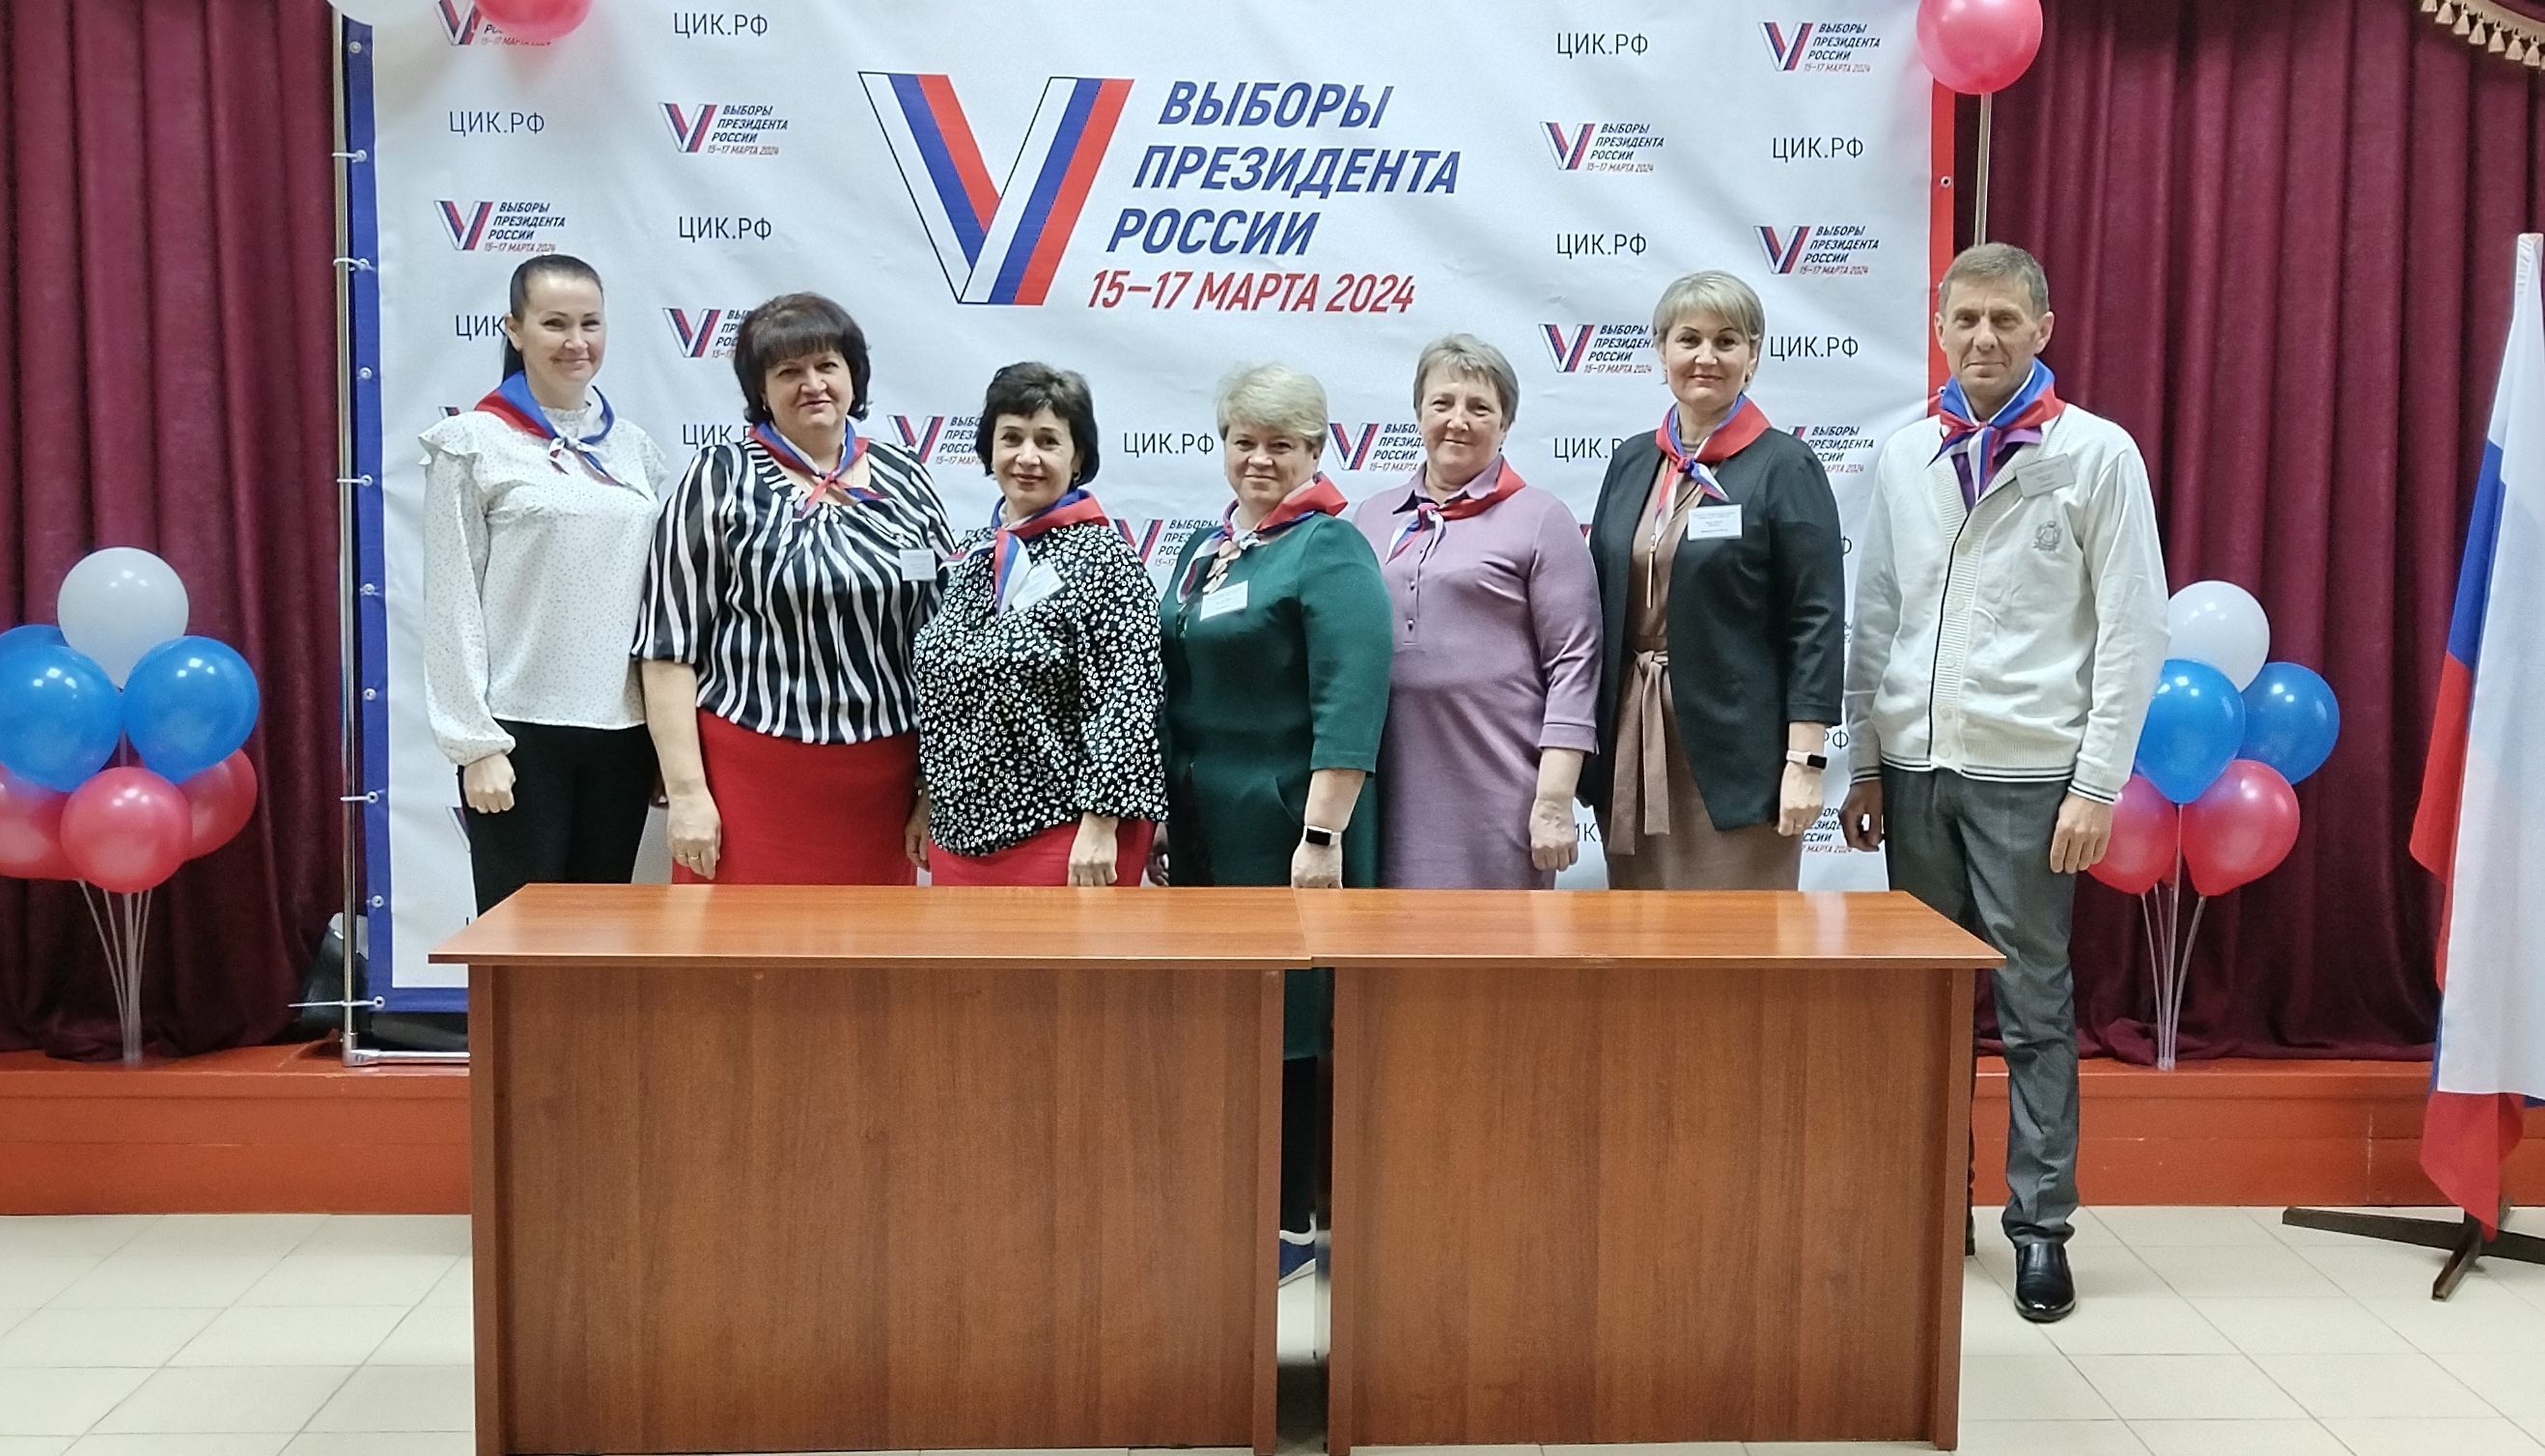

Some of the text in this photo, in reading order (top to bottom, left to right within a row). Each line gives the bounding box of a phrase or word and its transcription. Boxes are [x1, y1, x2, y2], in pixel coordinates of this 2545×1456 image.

[674, 13, 769, 39] ЦИК.РФ
[1818, 23, 1868, 34] ВЫБОРЫ
[1556, 33, 1649, 59] ЦИК.РФ
[1813, 37, 1881, 48] ПРЕЗИДЕНТА
[1807, 50, 1852, 61] РОССИИ
[1826, 63, 1851, 72] МАРТА
[1852, 64, 1871, 72] 2024
[1159, 80, 1394, 128] ВЫБОРЫ
[722, 104, 774, 116] ВЫБОРЫ
[449, 110, 545, 137] ЦИК.РФ
[716, 119, 789, 130] ПРЕЗИДЕНТА
[1601, 124, 1651, 133] ВЫБОРЫ
[711, 132, 758, 143] РОССИИ
[1595, 137, 1664, 148] ПРЕЗИДЕНТА
[731, 146, 758, 154] МАРТА
[759, 147, 779, 155] 2024
[1589, 150, 1635, 160] РОССИИ
[1773, 137, 1864, 163] ЦИК.РФ
[1132, 144, 1462, 199] ПРЕЗИДЕНТА
[1608, 163, 1635, 172] МАРТА
[498, 202, 551, 212] ВЫБОРЫ
[493, 215, 566, 227] ПРЕЗИДЕНТА
[488, 230, 535, 240] РОССИИ
[678, 216, 773, 244] ЦИК.РФ
[1106, 208, 1322, 256] РОССИИ
[1815, 226, 1866, 237] ВЫБОРЫ
[508, 243, 536, 252] МАРТА
[536, 243, 556, 252] 2024
[1556, 233, 1648, 260] ЦИК.РФ
[1809, 239, 1880, 250] ПРЕЗИДЕНТА
[1803, 253, 1849, 264] РОССИИ
[1822, 266, 1849, 274] МАРТА
[1849, 266, 1869, 275] 2024
[1195, 271, 1317, 313] МАРТА
[1325, 274, 1416, 314] 2024
[456, 315, 507, 341] ЦИК
[1599, 324, 1650, 335] ВЫБОРЫ
[1593, 338, 1655, 349] ПРЕЗИДЕН
[1769, 335, 1860, 361] ЦИК.РФ
[1588, 351, 1634, 361] РОССИИ
[1606, 365, 1633, 374] МАРТА
[1633, 365, 1653, 374] 2024
[950, 416, 981, 427] ВЫБО
[1384, 423, 1419, 434] ВЫБО
[1811, 426, 1860, 436] ВЫБОРЫ
[1123, 432, 1215, 459] ЦИК.РФ
[1378, 436, 1424, 448] ПРЕЗИД
[1554, 437, 1624, 462] ЦИК.Р
[1373, 450, 1418, 461] РОССИИ
[1816, 452, 1845, 462] ССИИ
[1391, 462, 1418, 471] МАРТА
[1158, 546, 1181, 555] РОС
[1804, 832, 1832, 842] ССИИ
